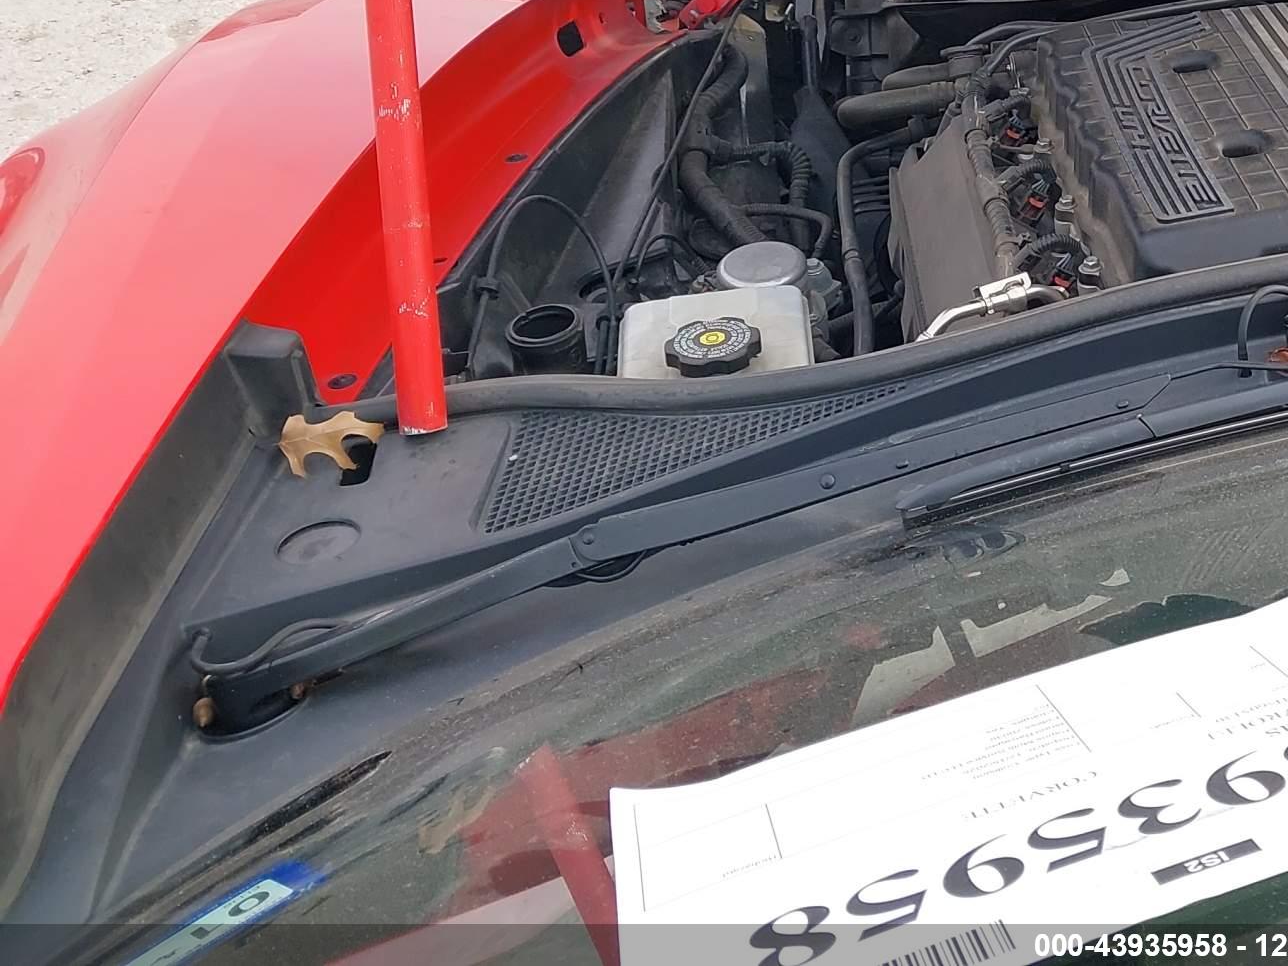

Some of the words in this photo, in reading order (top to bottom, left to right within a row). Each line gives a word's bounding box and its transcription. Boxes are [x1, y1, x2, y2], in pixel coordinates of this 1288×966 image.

[1128, 63, 1219, 212] CORVETTE
[960, 770, 1098, 819] CORVETTE
[1183, 851, 1231, 872] IS2
